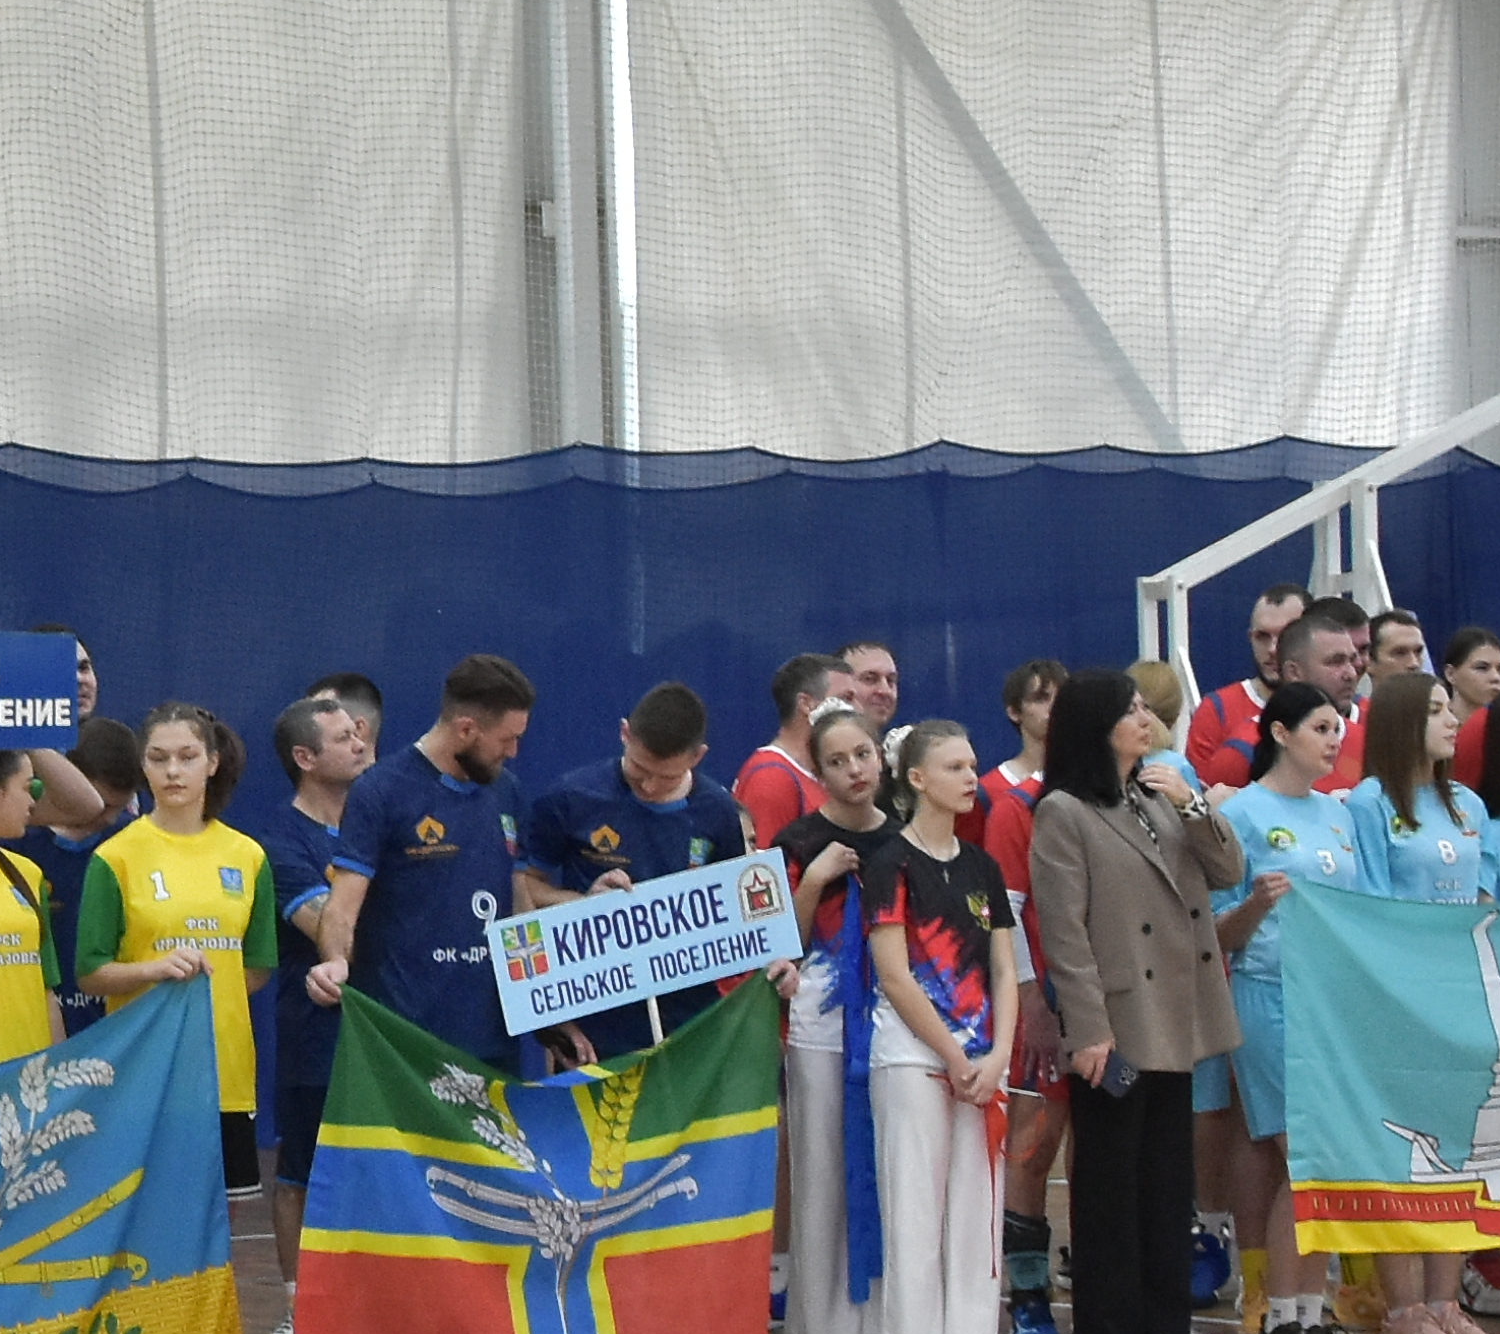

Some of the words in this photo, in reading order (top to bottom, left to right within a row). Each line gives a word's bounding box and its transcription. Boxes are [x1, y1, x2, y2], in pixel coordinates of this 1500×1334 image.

[1316, 850, 1338, 876] 3
[1438, 838, 1459, 866] 8
[149, 869, 171, 901] 1
[470, 889, 498, 936] 9
[551, 883, 730, 968] КИРОВСКОЕ
[432, 947, 457, 963] ФК
[530, 963, 638, 1016] СЕЛЬСКОЕ
[649, 926, 773, 983] ПОСЕЛЕНИЕ
